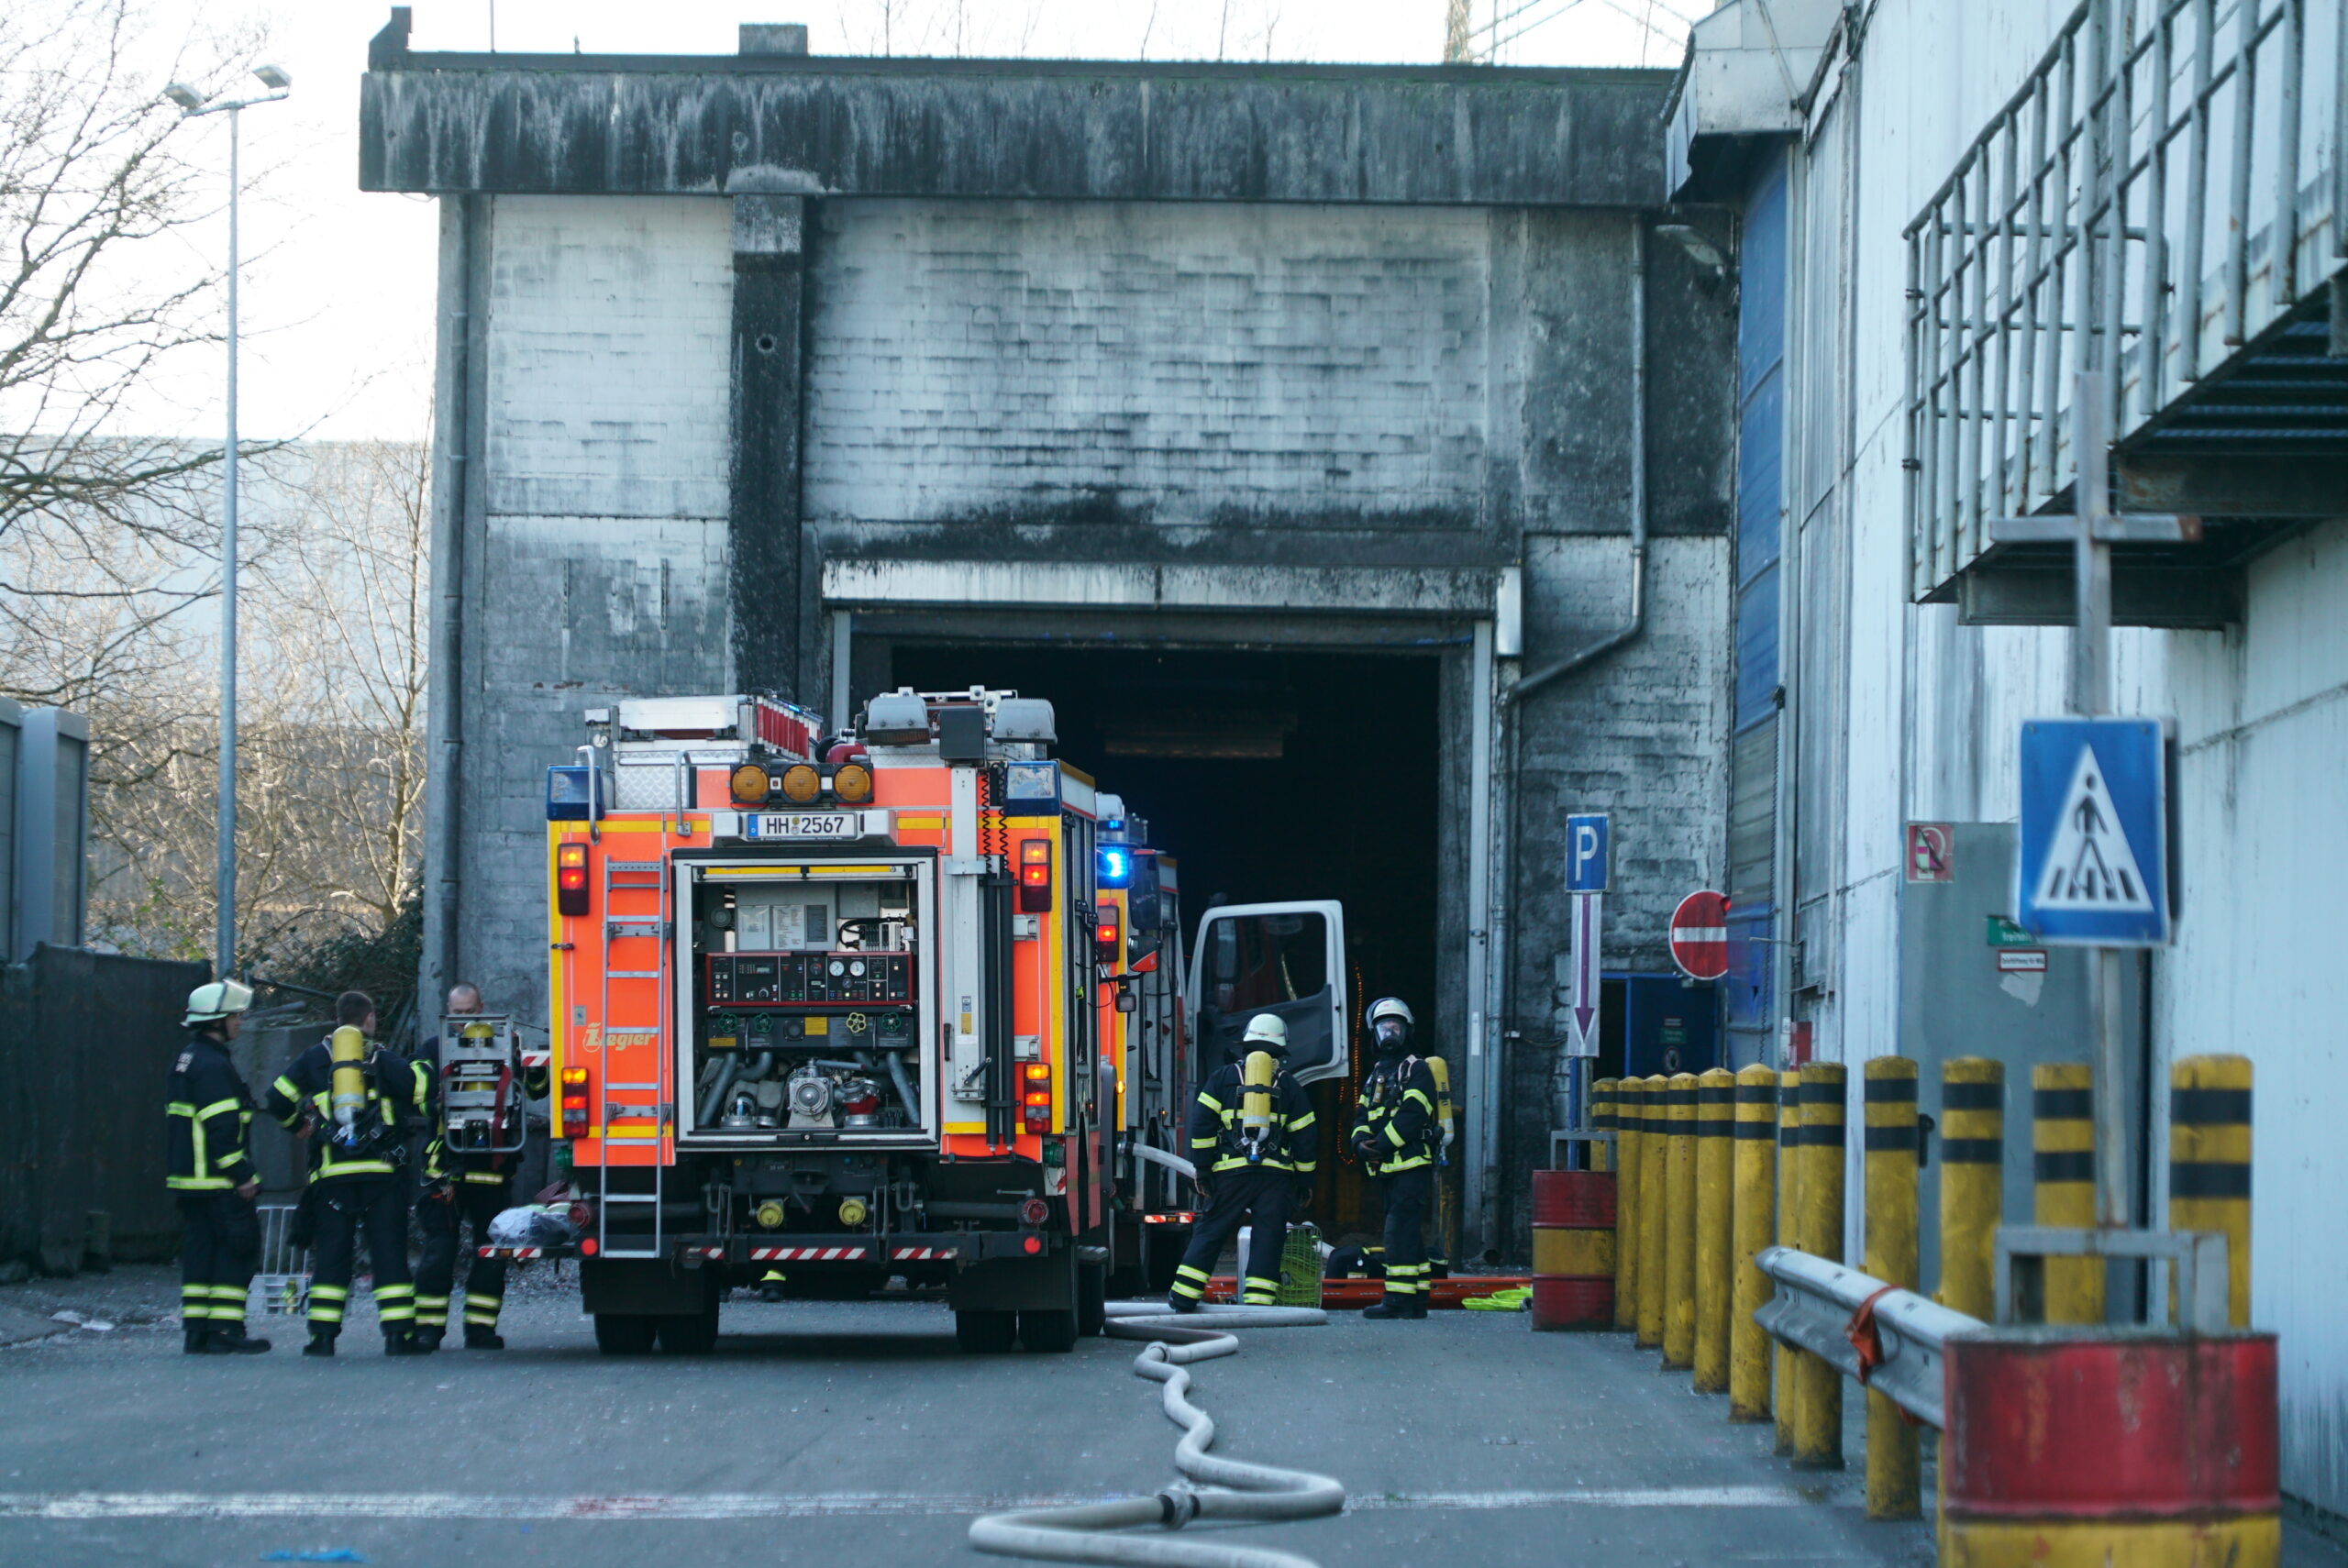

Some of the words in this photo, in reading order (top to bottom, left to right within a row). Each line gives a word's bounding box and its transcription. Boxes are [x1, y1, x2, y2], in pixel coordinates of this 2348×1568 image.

[766, 817, 789, 834] HH
[802, 817, 844, 834] 2567
[1575, 825, 1598, 881] P
